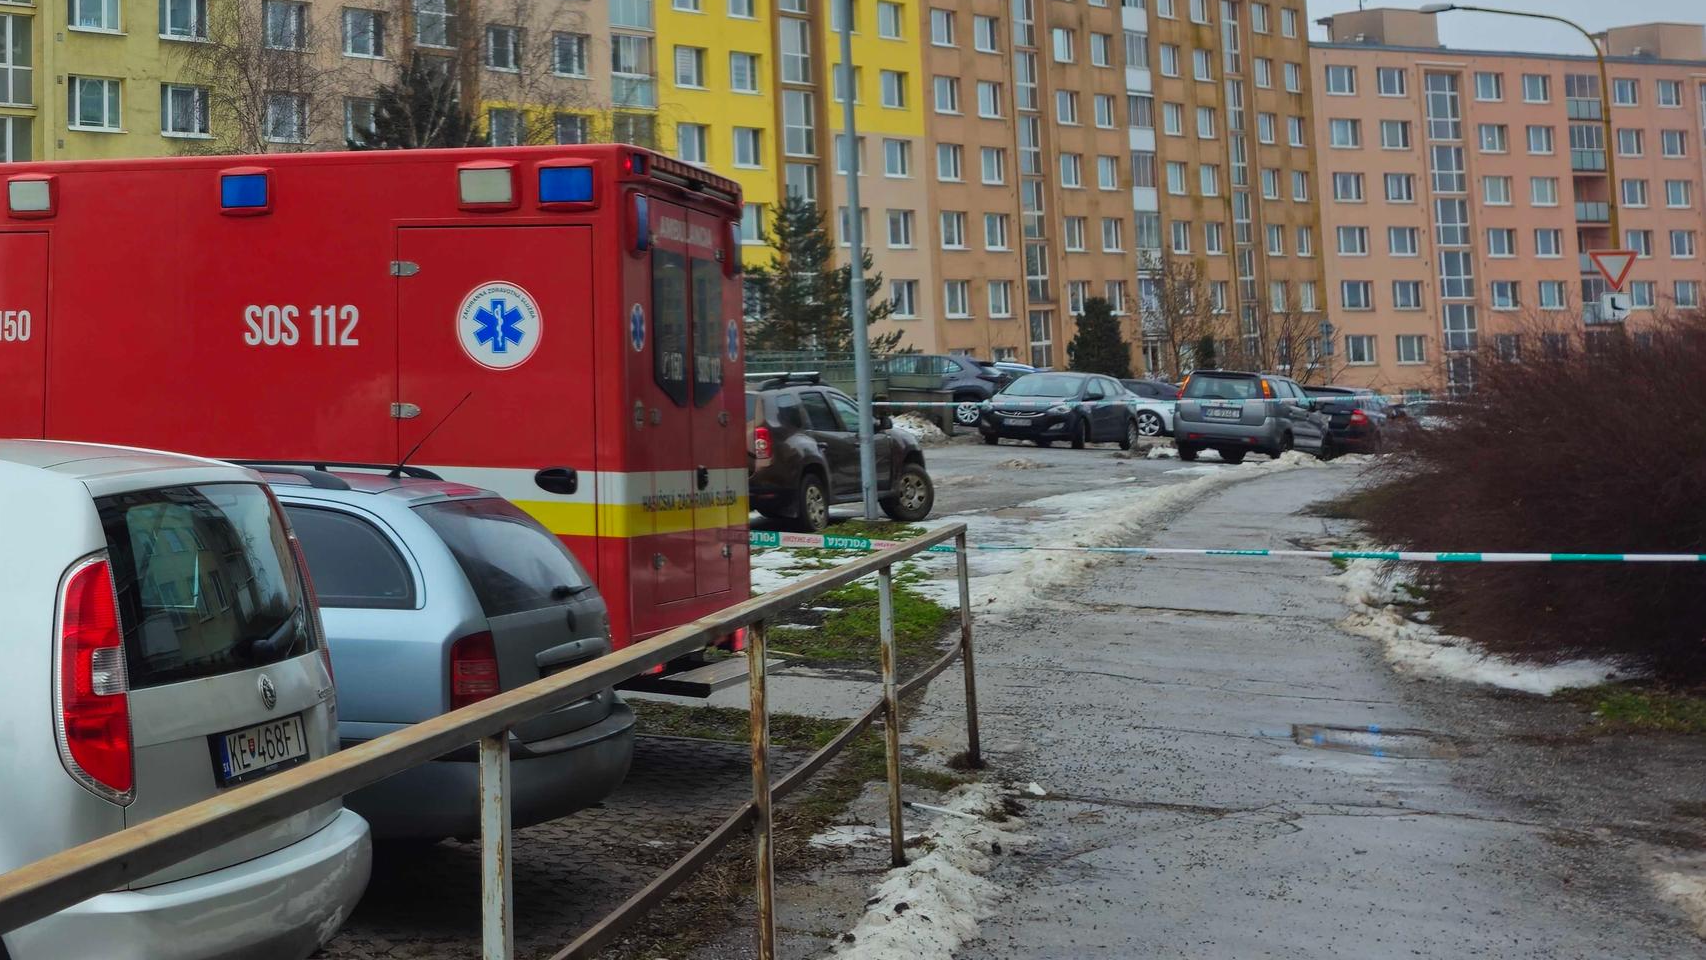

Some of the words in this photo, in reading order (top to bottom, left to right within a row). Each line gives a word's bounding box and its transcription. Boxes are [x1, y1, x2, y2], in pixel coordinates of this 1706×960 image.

[244, 304, 300, 346] SOS
[310, 304, 360, 346] 112
[228, 734, 251, 772] KE
